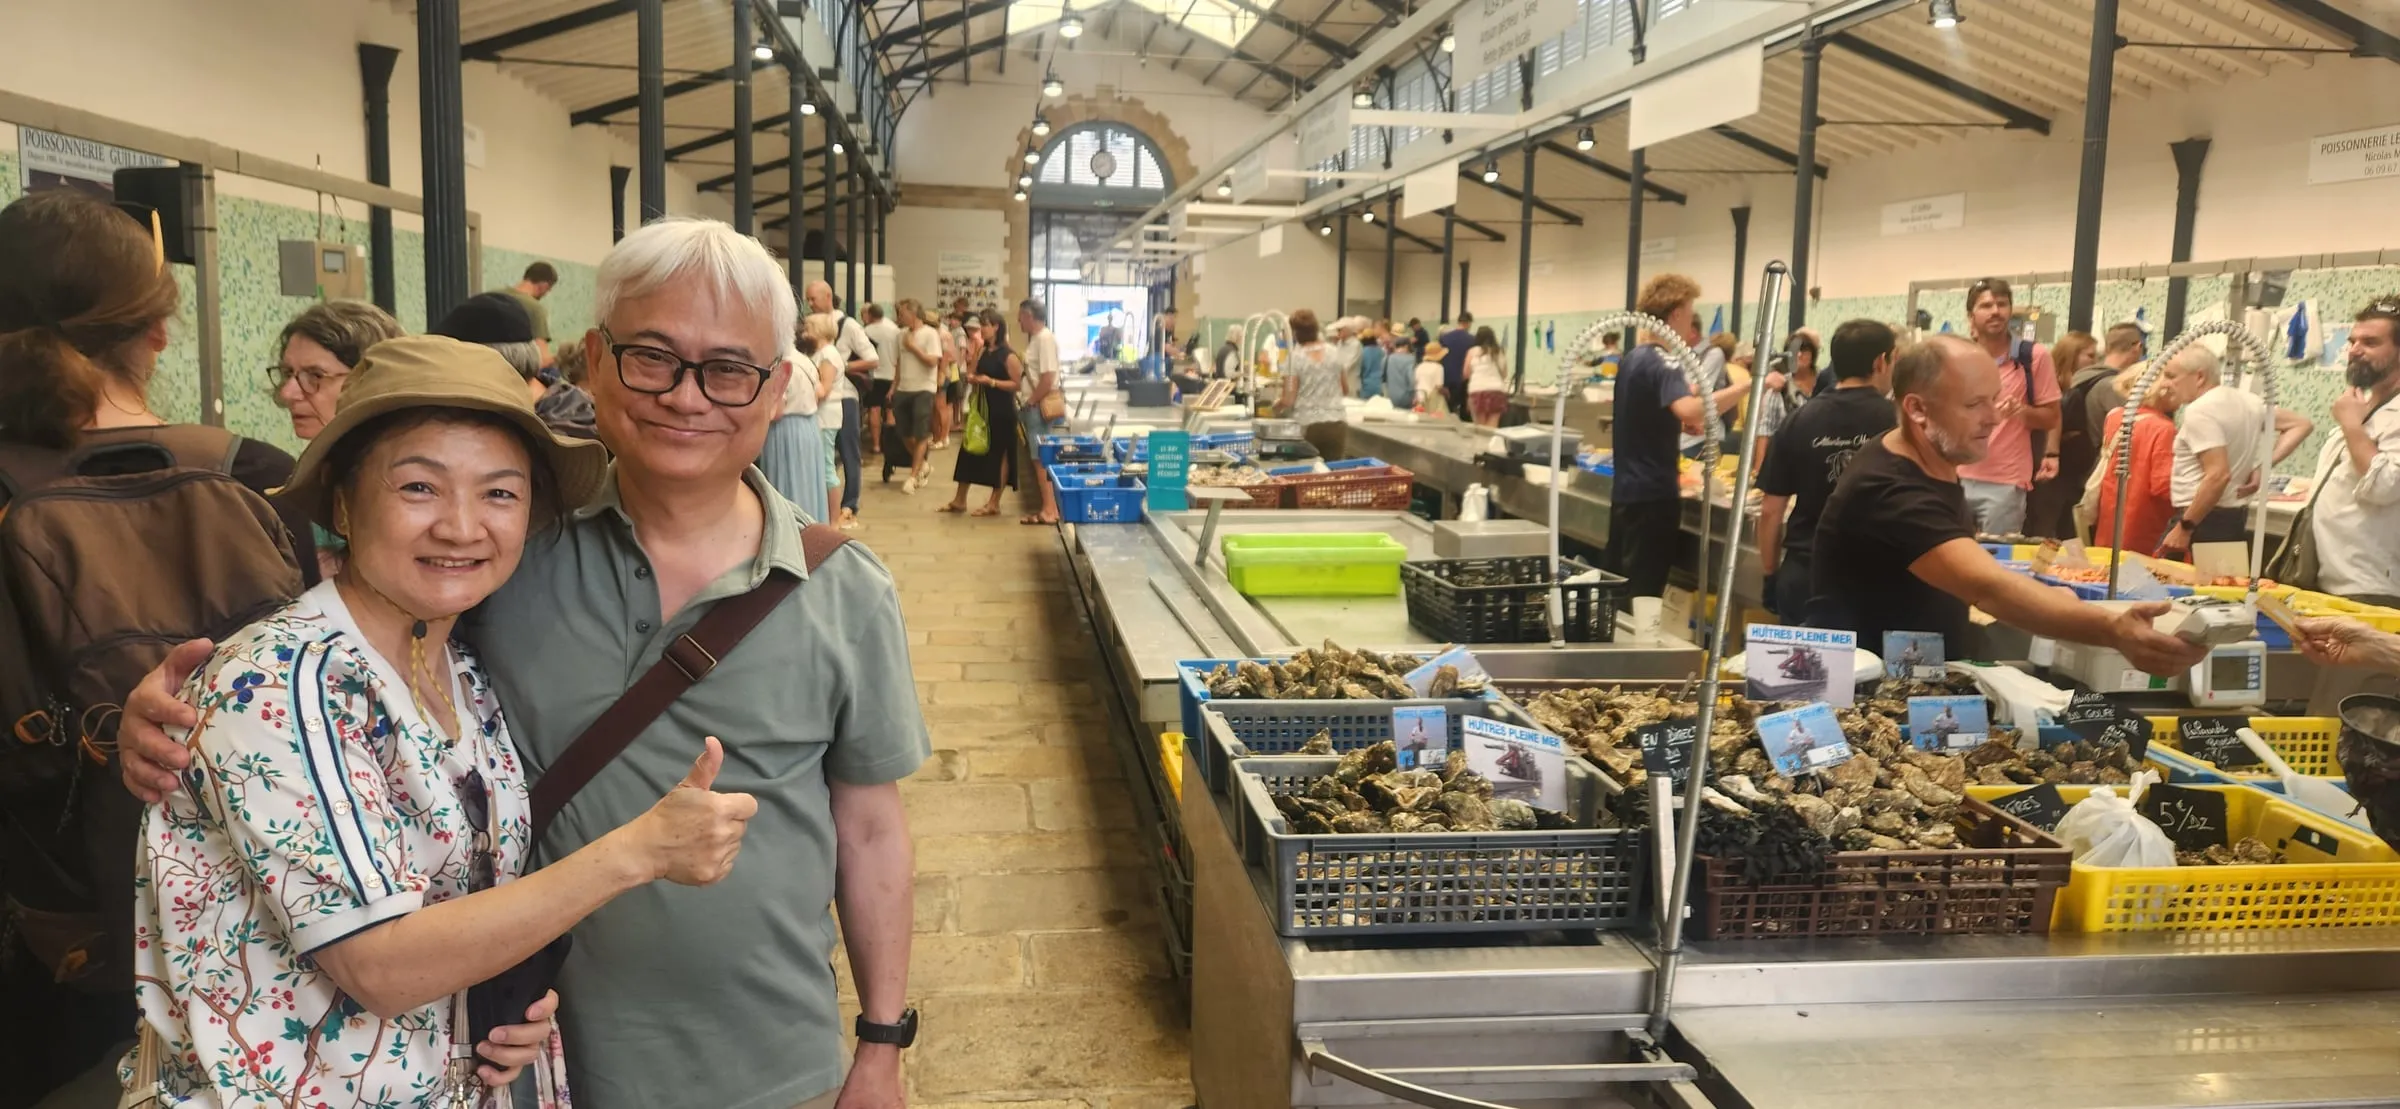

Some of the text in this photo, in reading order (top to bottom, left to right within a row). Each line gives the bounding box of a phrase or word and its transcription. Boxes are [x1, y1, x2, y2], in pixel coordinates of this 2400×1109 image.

[25, 127, 105, 161] POISSONNERIE
[2321, 134, 2387, 155] POISSONNERIE
[2365, 151, 2392, 161] Nicolas
[1752, 627, 1853, 644] HUÎTRES PLEINE MER
[1468, 718, 1561, 749] HUÎTRES PLEINE MER
[1641, 732, 1659, 747] EN
